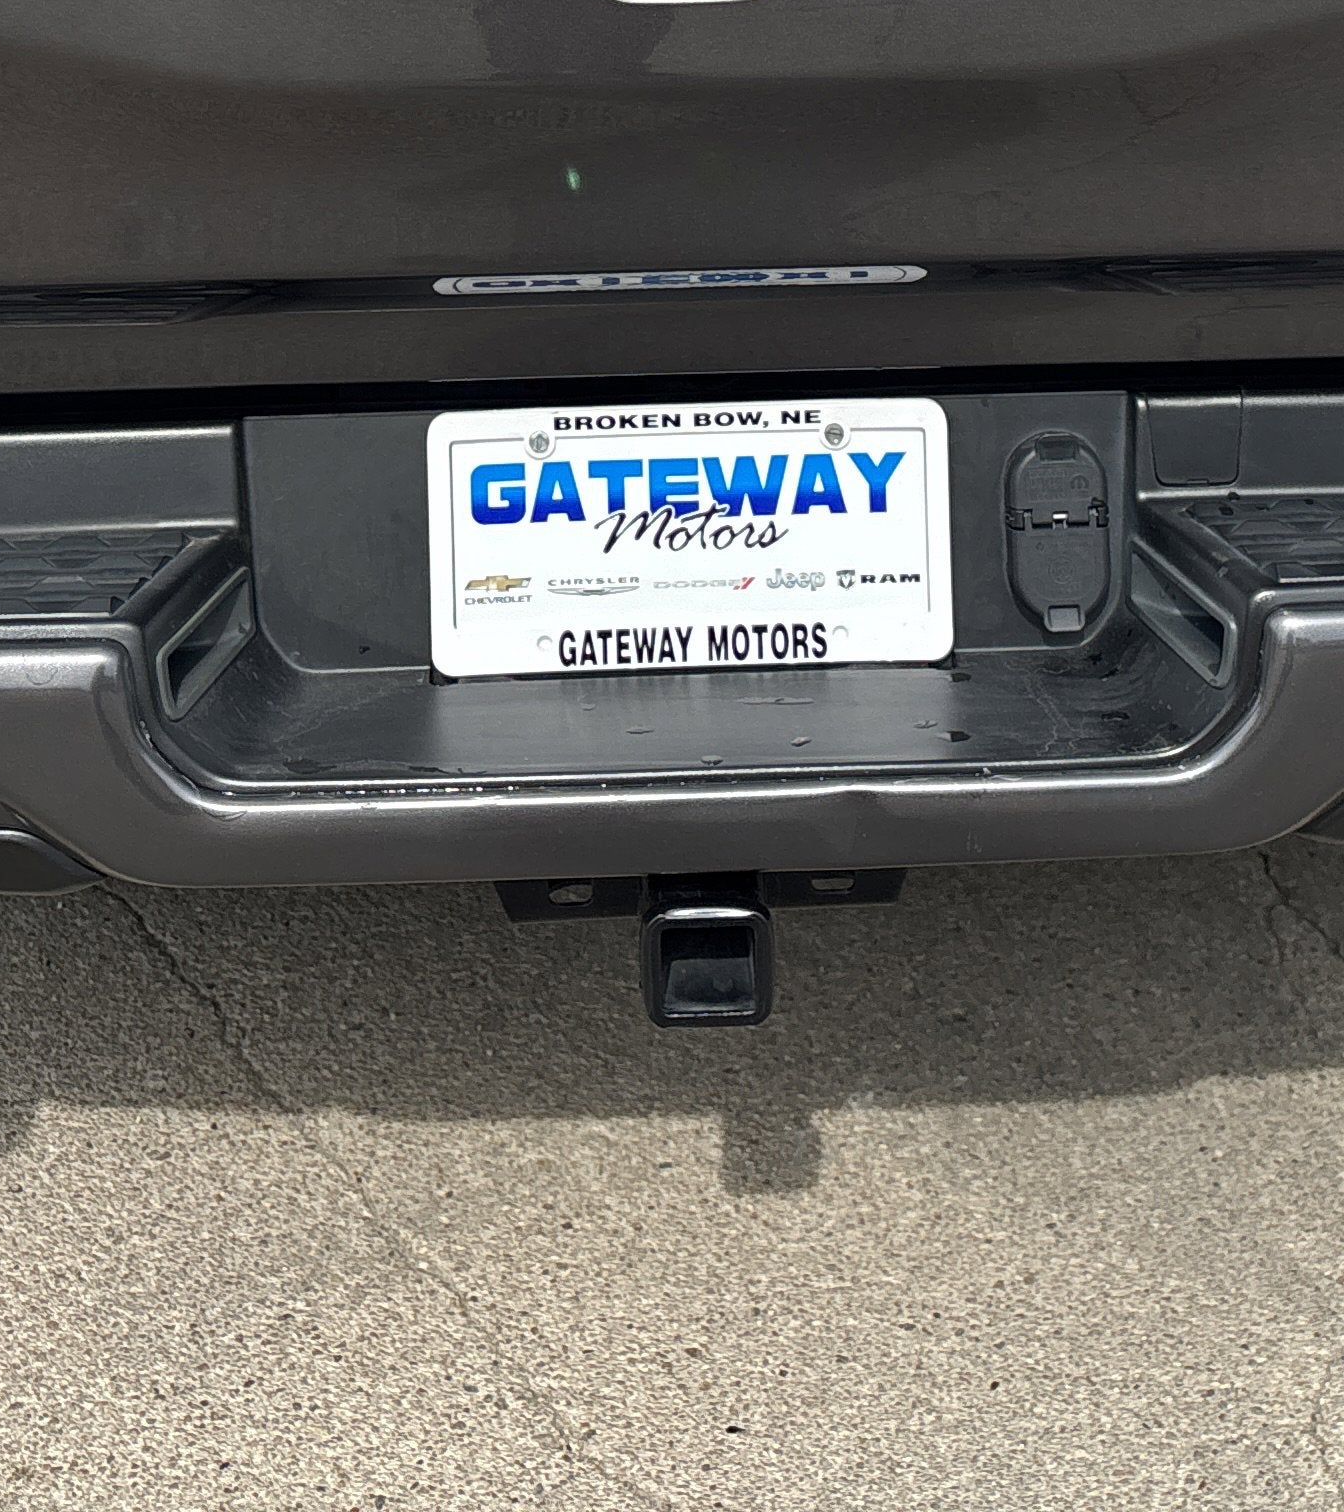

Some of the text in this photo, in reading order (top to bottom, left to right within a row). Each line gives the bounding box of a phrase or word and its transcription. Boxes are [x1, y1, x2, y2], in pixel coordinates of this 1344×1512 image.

[553, 408, 823, 432] BROKEN BOW, NE
[469, 450, 908, 526] GATEWAY
[593, 501, 790, 555] Motors
[546, 575, 641, 588] CHRYSLER
[765, 567, 826, 592] Jeep
[860, 573, 922, 585] RAM
[464, 593, 533, 606] CHEVROLET
[557, 621, 828, 667] GATEWAY MOTORS
